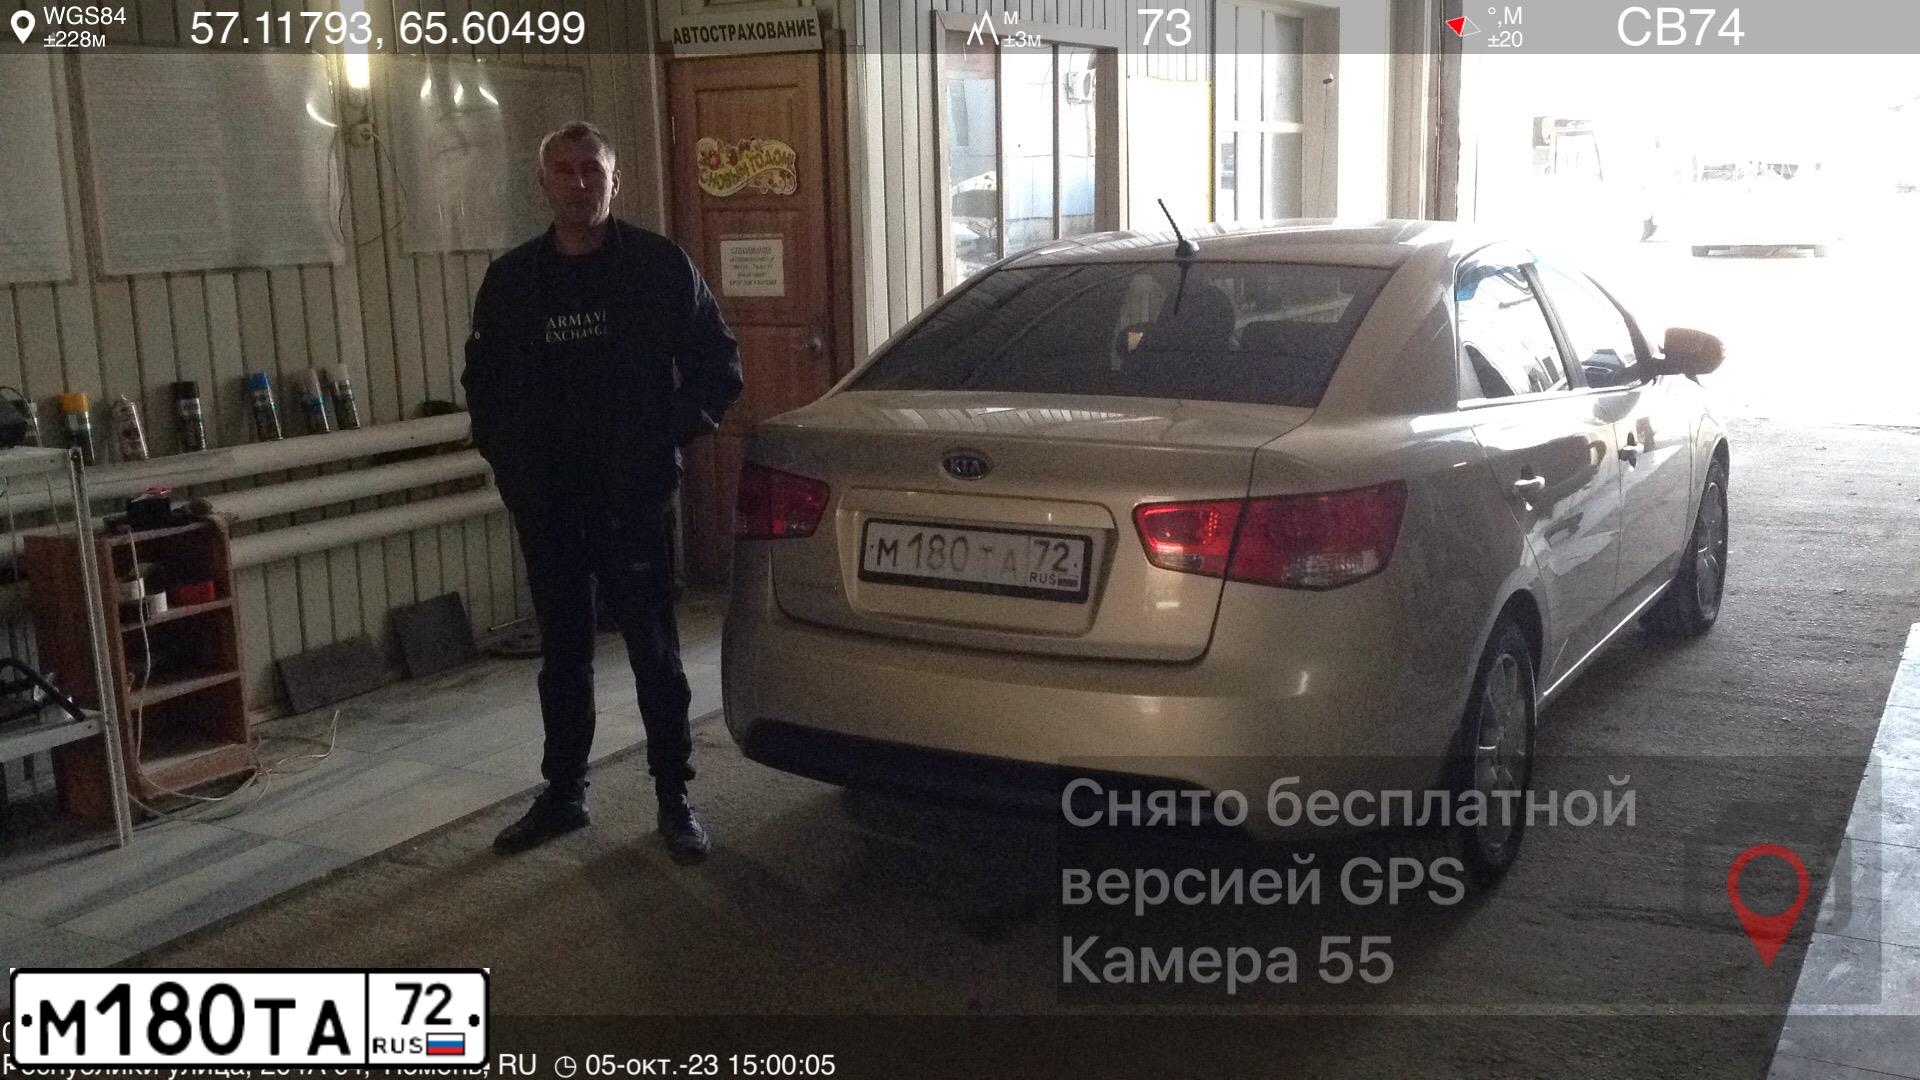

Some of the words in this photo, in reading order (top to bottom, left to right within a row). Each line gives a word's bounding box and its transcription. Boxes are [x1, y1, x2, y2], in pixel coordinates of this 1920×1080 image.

[672, 18, 817, 46] АВТОСТРАХОВАНИЕ
[547, 308, 606, 329] ARMANI
[950, 459, 979, 474] KIA
[1032, 539, 1070, 573] 72
[1029, 572, 1057, 586] RUS
